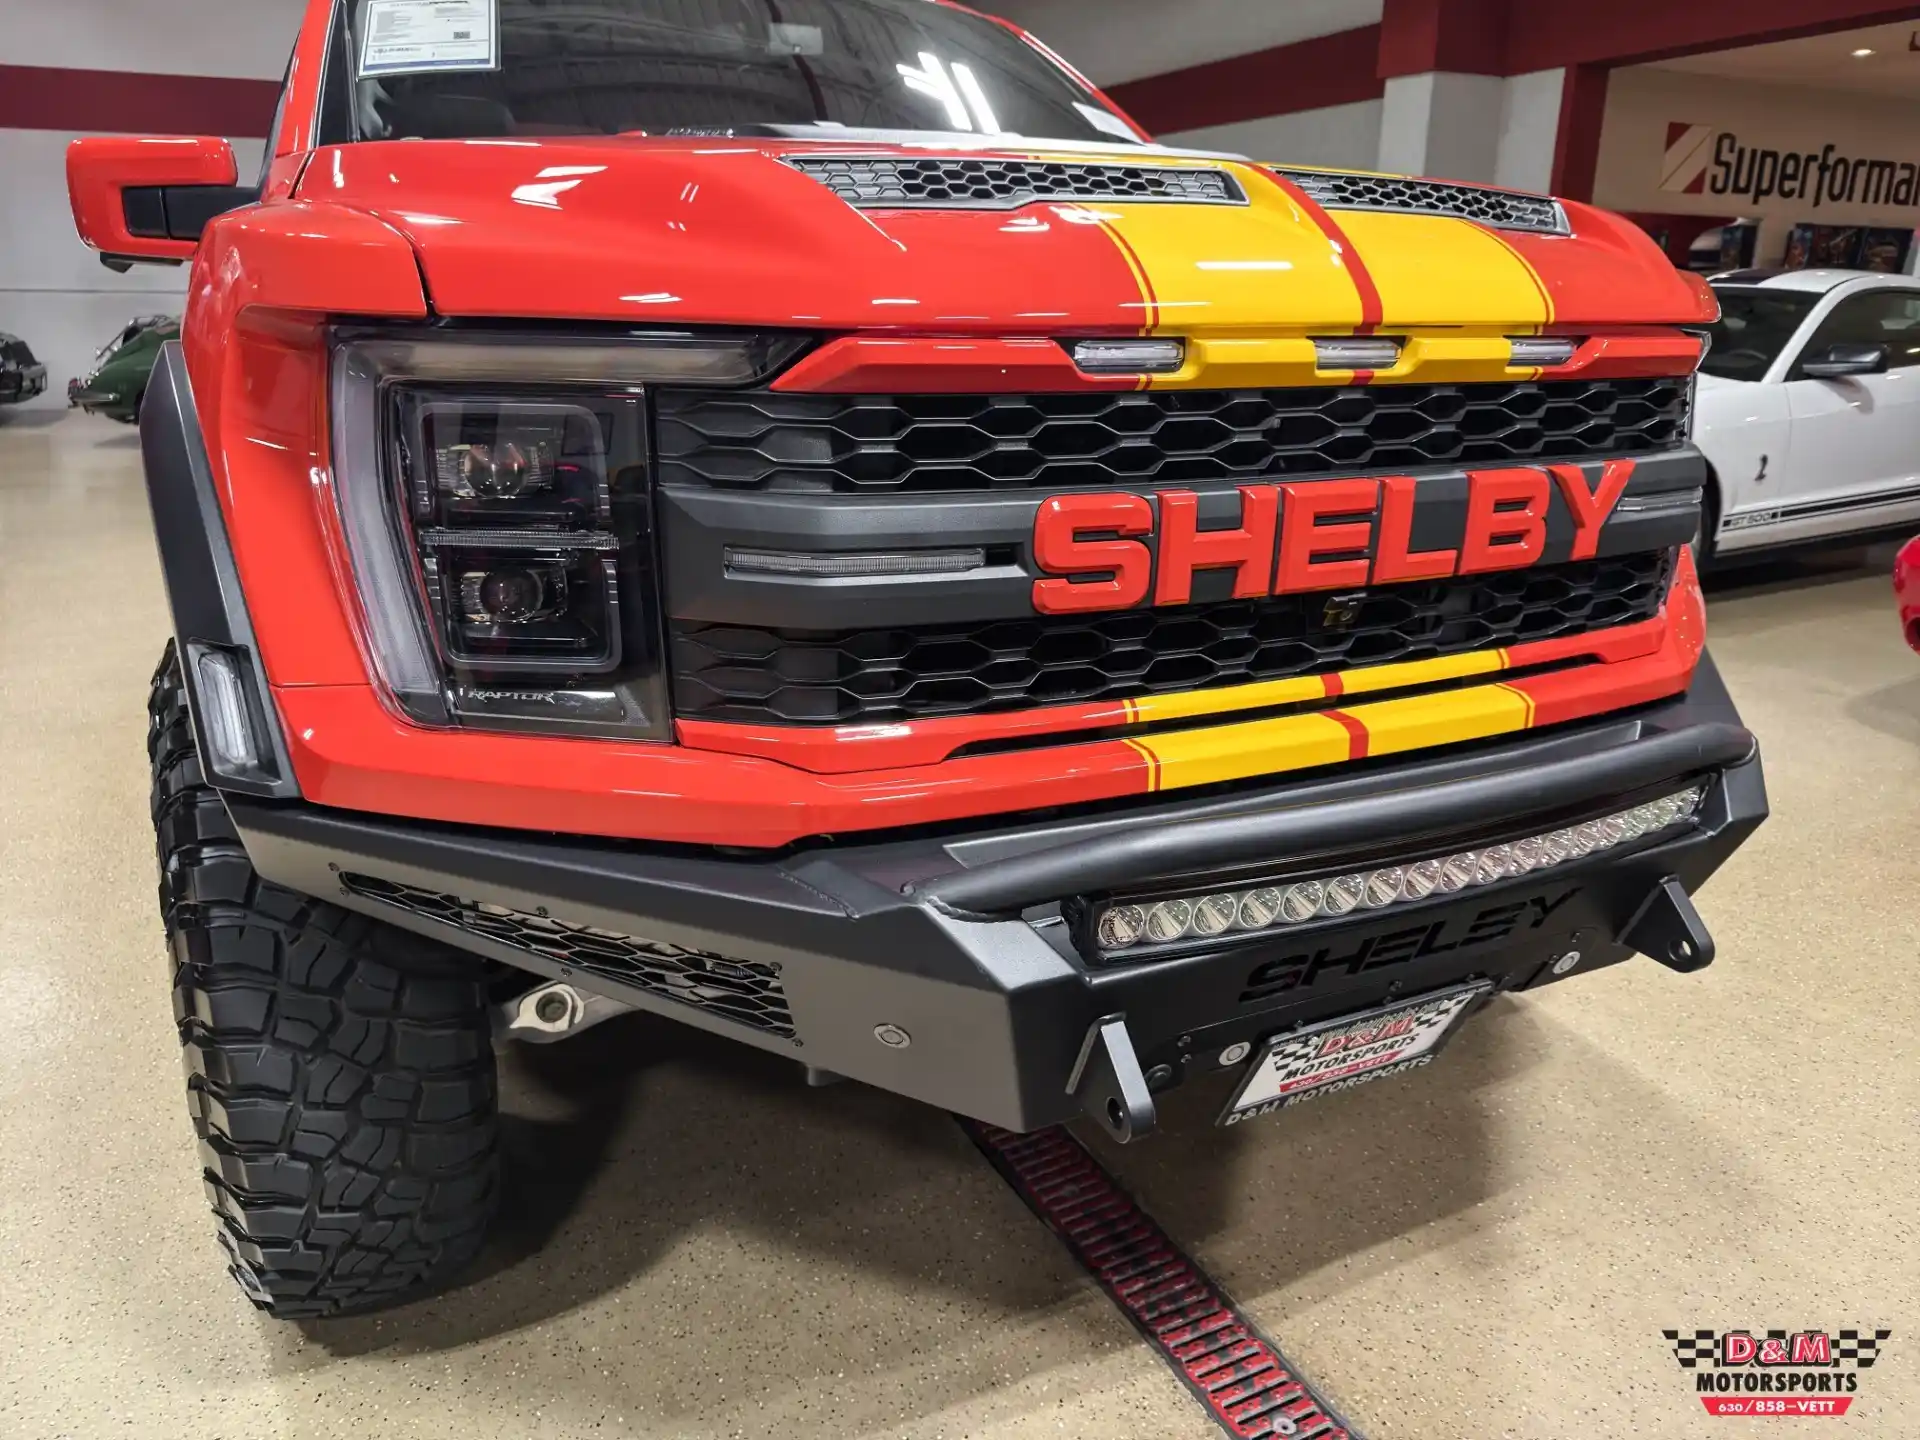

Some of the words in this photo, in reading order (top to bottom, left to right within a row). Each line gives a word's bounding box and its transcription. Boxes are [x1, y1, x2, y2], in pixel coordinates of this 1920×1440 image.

[1031, 458, 1636, 616] SHELBY
[467, 689, 555, 704] RAPTOR
[1239, 886, 1585, 1003] SHELBY
[1280, 1033, 1420, 1081] MOTORSPORTS
[1317, 1014, 1415, 1058] D&M
[1225, 1100, 1278, 1127] D&M
[1283, 1054, 1434, 1109] MOTORSPORTS
